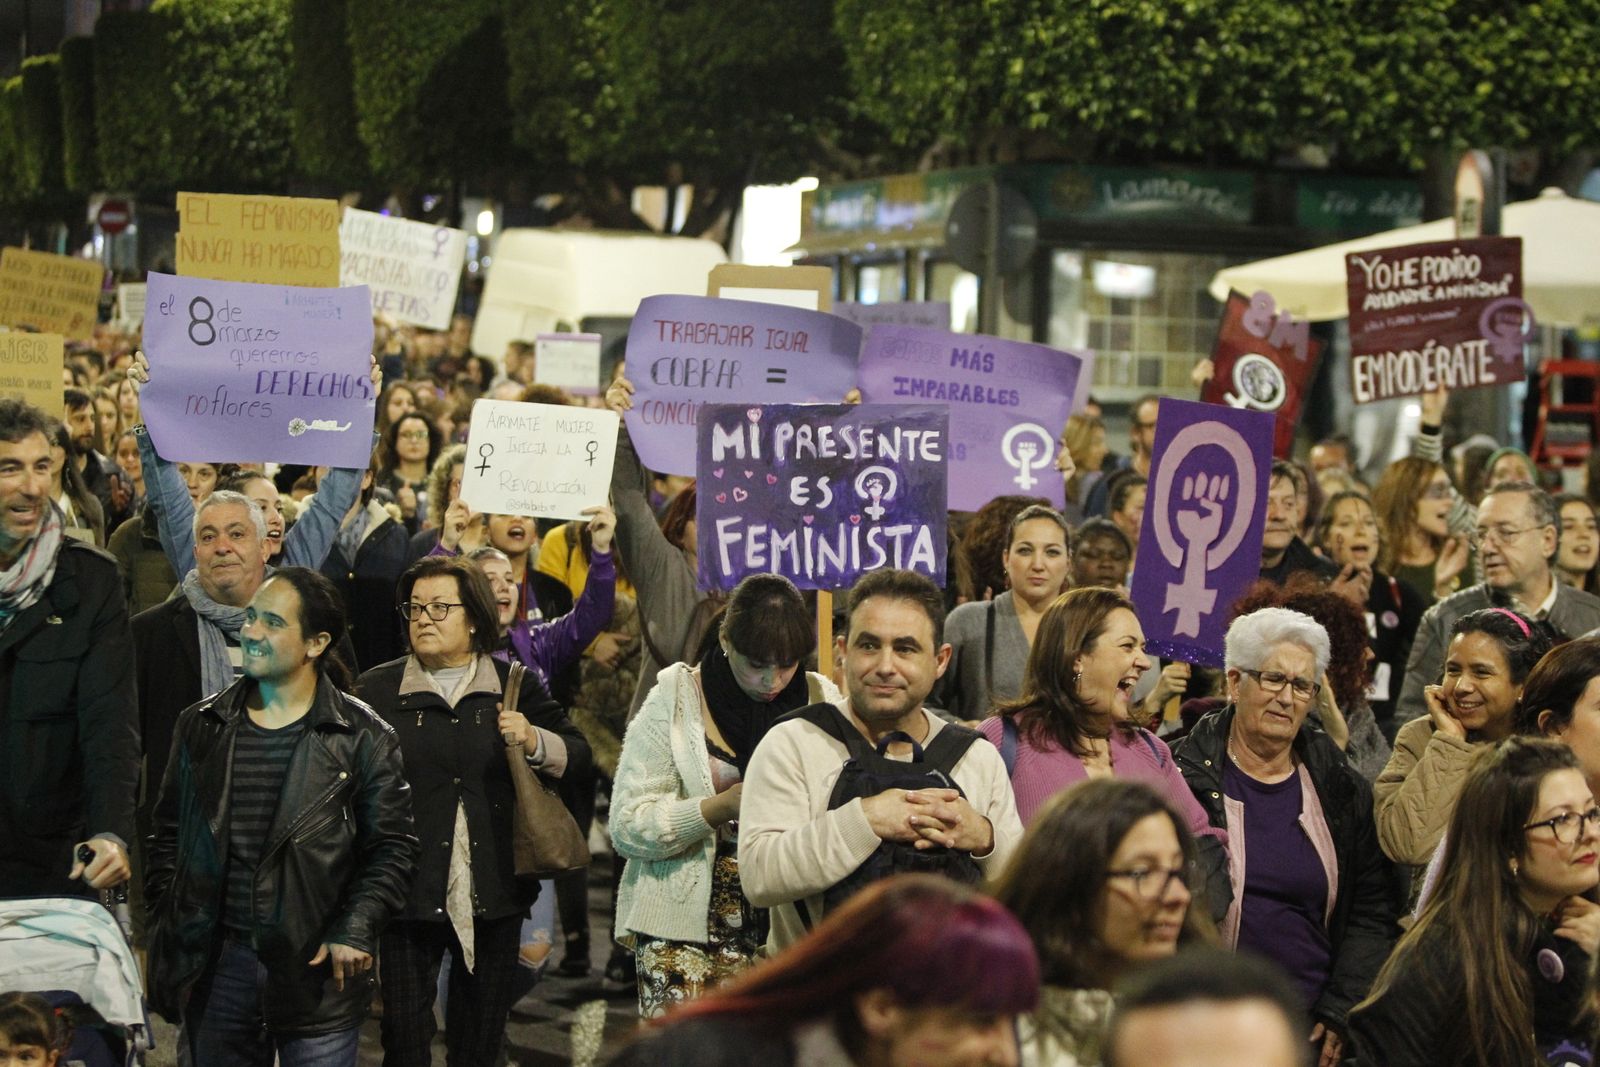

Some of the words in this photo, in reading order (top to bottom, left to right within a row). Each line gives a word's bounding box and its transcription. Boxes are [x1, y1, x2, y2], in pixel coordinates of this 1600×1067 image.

[186, 196, 220, 226] EL
[241, 201, 334, 232] FEMINISMO
[180, 235, 232, 263] NUNCA
[242, 240, 263, 268] HA
[269, 243, 335, 269] MATADO
[1393, 258, 1420, 287] HE
[1421, 247, 1482, 284] PODIDO
[1362, 286, 1434, 311] AYUDARME
[160, 294, 175, 316] el
[188, 296, 216, 346] 8
[217, 300, 243, 322] de
[218, 325, 281, 342] marzo
[653, 319, 754, 347] TRABAJAR
[765, 328, 809, 353] IGUAL
[230, 348, 321, 371] queremos
[651, 357, 744, 389] COBRAR
[950, 345, 995, 373] MÁS
[1353, 339, 1497, 402] EMPODÉRATE
[211, 384, 273, 418] flores
[893, 376, 1020, 407] IMPARABLES
[556, 420, 598, 433] MUJER
[641, 399, 697, 426] CONCIL
[557, 445, 572, 456] LA
[712, 421, 760, 462] MI
[775, 421, 942, 463] PRESENTE
[499, 469, 587, 496] REVOLUCIÓN
[790, 476, 833, 509] ES
[716, 515, 936, 579] FEMINISTA
